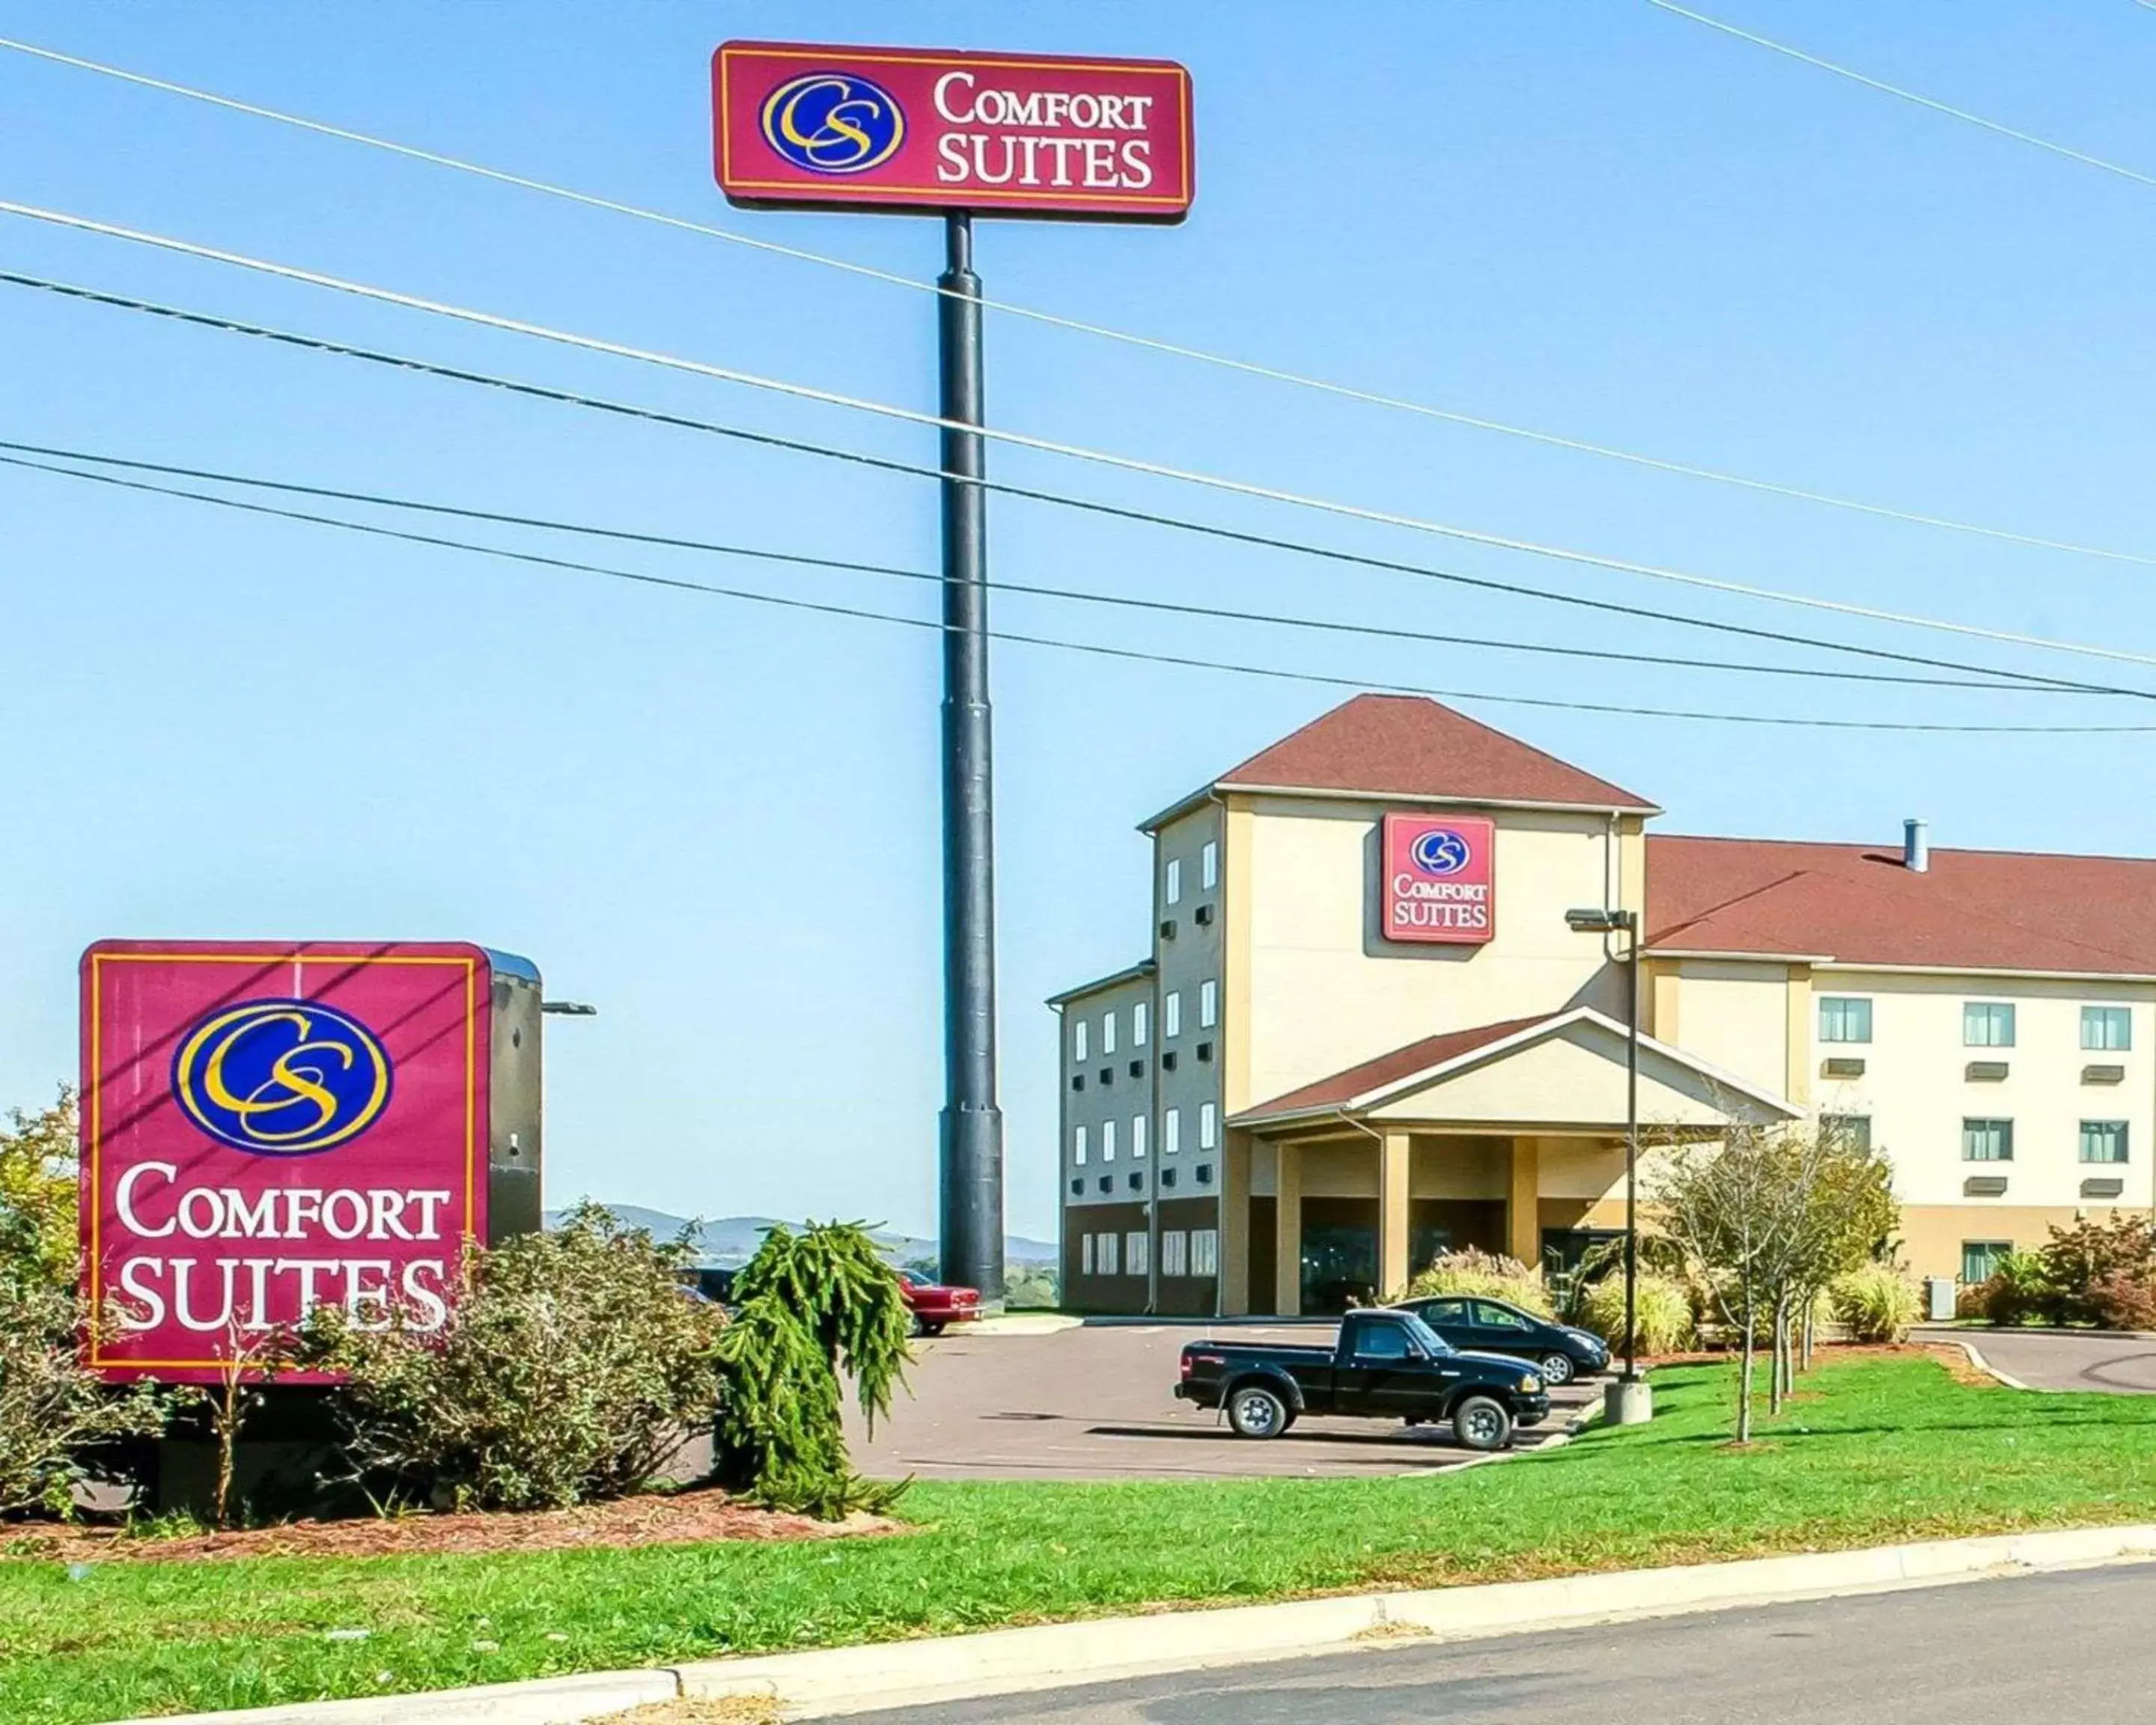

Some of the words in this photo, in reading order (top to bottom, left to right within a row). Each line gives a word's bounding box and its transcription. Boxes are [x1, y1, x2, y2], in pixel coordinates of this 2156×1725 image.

[780, 81, 880, 166] CS
[934, 72, 1152, 130] COMFORT
[938, 134, 1152, 188] SUITES
[1394, 874, 1487, 900] COMFORT
[1395, 901, 1487, 927] SUITES
[205, 1012, 353, 1140] CS
[115, 1161, 450, 1240] COMFORT
[121, 1257, 445, 1333] SUITES
